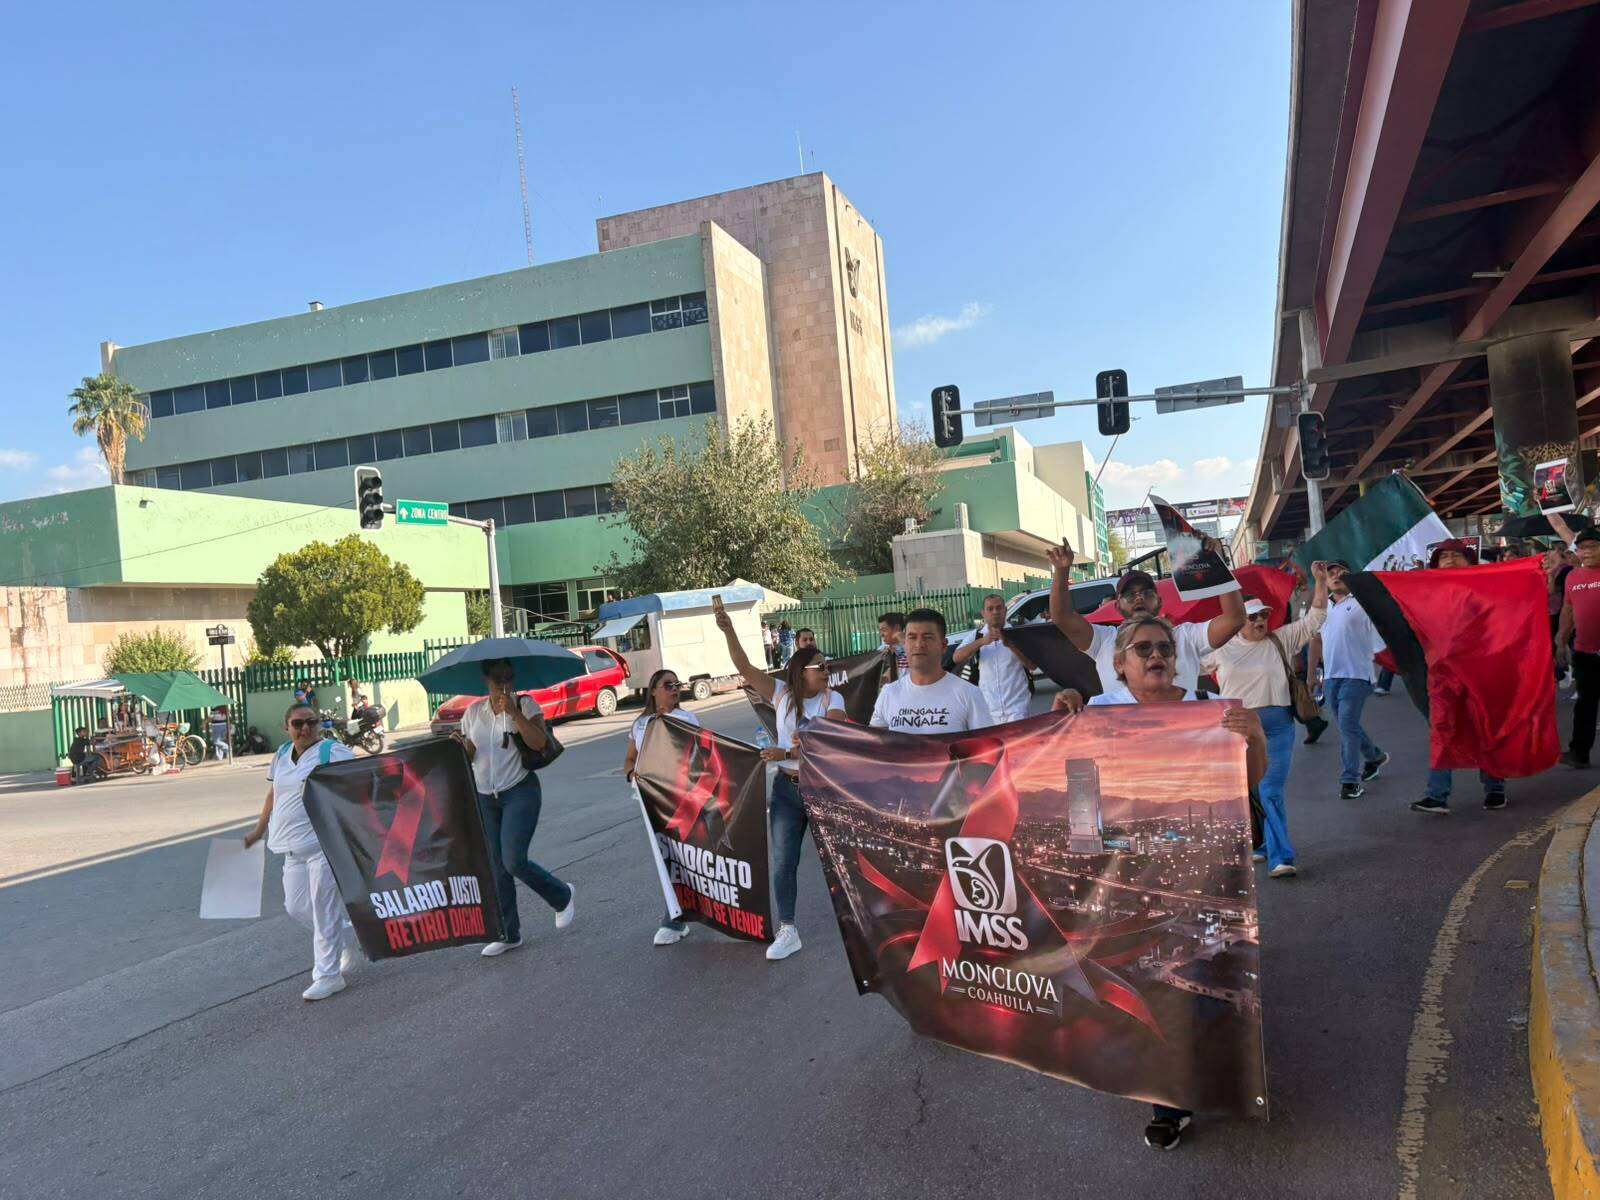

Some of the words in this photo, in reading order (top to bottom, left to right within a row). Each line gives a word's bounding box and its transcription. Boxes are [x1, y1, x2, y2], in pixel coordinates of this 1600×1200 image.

[411, 507, 426, 519] ZONA
[427, 508, 448, 520] CENTRO
[827, 670, 849, 688] UILA
[890, 715, 948, 728] CHINGALE
[899, 707, 949, 716] CHINGALE
[655, 832, 752, 889] SINDICATO
[370, 880, 448, 919] SALARIO
[448, 876, 481, 905] JUSTO
[671, 862, 740, 908] ENTIENDE
[385, 910, 449, 951] RETIRO
[449, 907, 486, 937] DIGNO
[712, 901, 728, 927] SE
[728, 906, 765, 939] VENDE
[954, 909, 1028, 951] IMSS
[942, 956, 1060, 1003] MONCLOVA
[967, 986, 1035, 1014] COAHUILA
